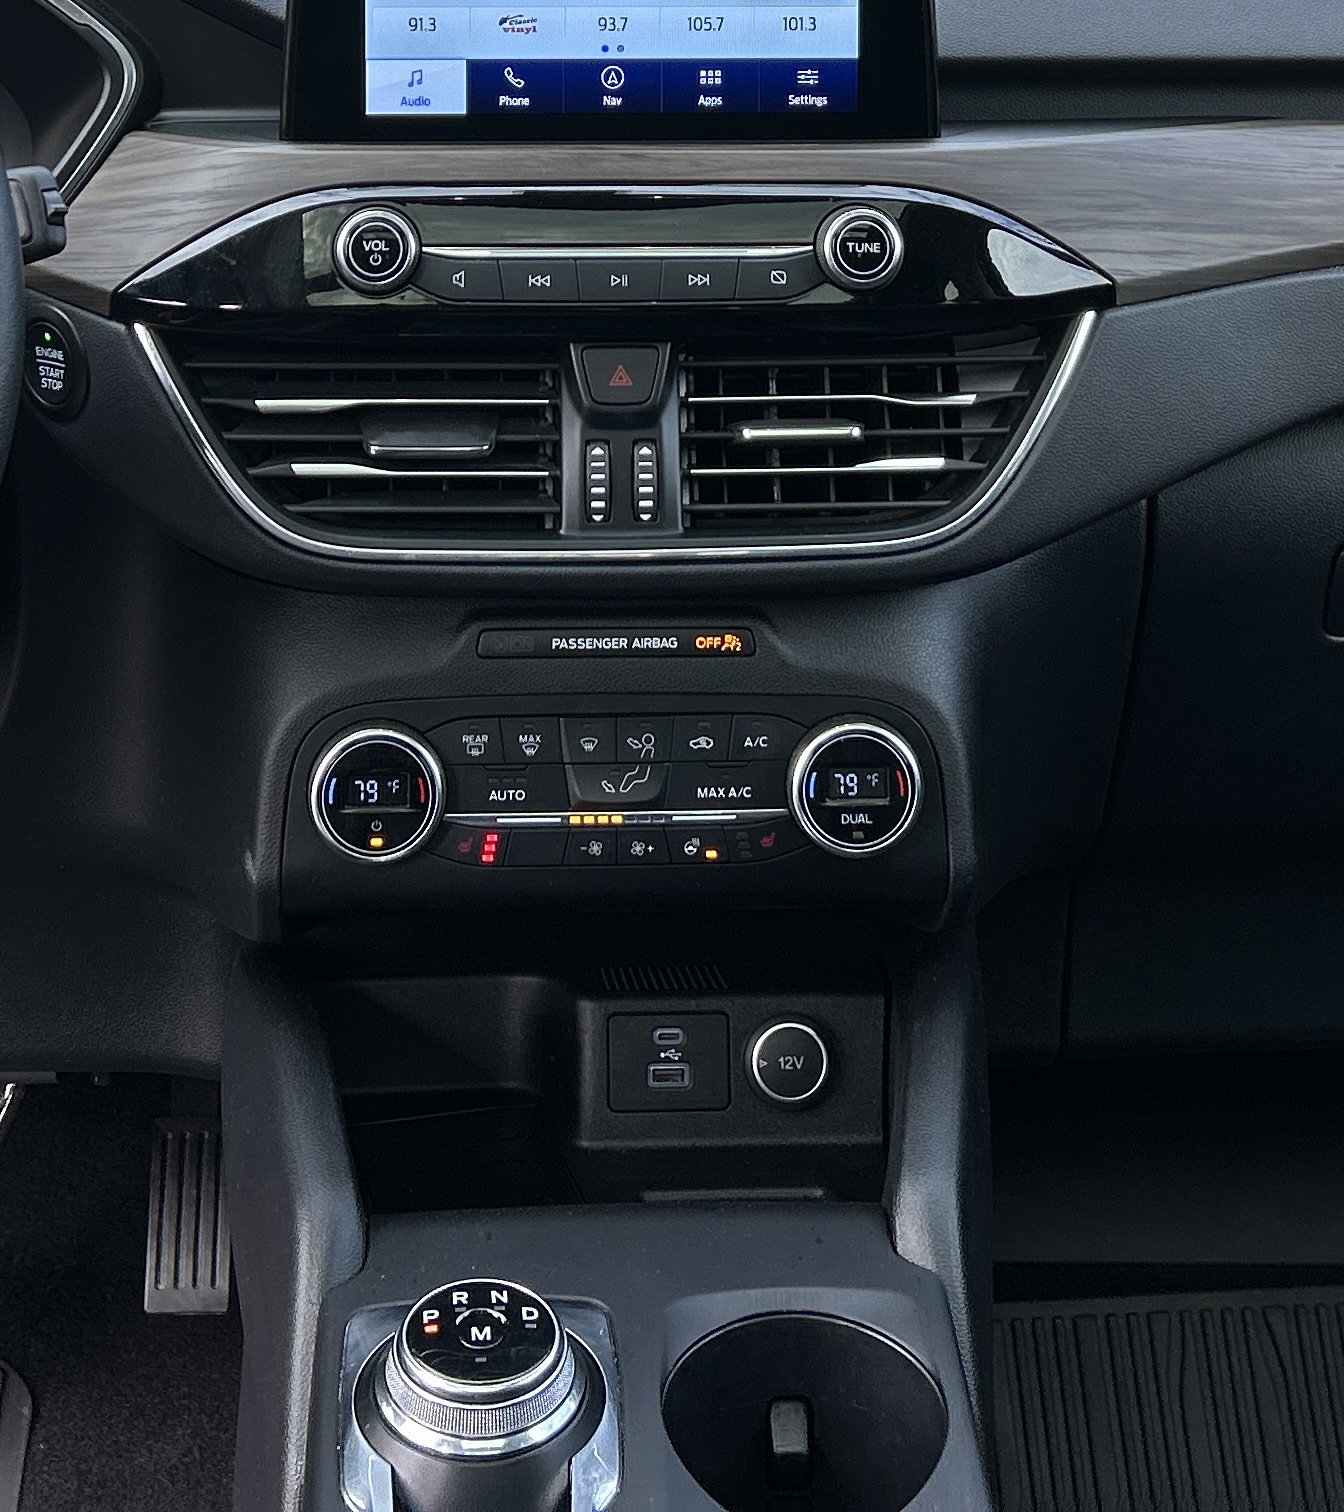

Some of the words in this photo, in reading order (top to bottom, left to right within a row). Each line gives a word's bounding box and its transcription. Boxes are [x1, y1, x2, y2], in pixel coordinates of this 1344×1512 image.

[408, 16, 437, 32] 91.3
[509, 17, 538, 25] Classic
[598, 16, 628, 32] 93.7
[687, 16, 724, 32] 105.7
[783, 16, 817, 32] 101.3
[503, 25, 537, 34] vinyl
[400, 95, 431, 108] Audio
[499, 95, 530, 107] Phone
[603, 95, 622, 107] Nav
[698, 95, 722, 109] Apps
[788, 94, 828, 109] Settings
[363, 240, 390, 252] VOL
[846, 242, 882, 254] TUNE
[35, 346, 64, 361] ENGINE
[38, 366, 65, 380] START
[40, 378, 64, 391] STOP
[552, 637, 628, 650] PASSENGER
[632, 637, 678, 650] AIRBAG
[695, 636, 722, 650] OFF
[462, 735, 489, 744] REAR
[518, 734, 542, 744] MAX
[743, 736, 768, 749] A/C
[834, 773, 858, 796] 79
[355, 780, 378, 803] 79
[489, 789, 526, 802] AUTO
[697, 786, 722, 799] MAX
[723, 786, 752, 799] A/C
[841, 813, 873, 825] DUAL
[778, 1057, 804, 1070] 12V
[452, 1291, 469, 1305] R
[491, 1290, 509, 1304] N
[422, 1310, 440, 1324] P
[522, 1307, 539, 1321] D
[471, 1326, 491, 1341] M
